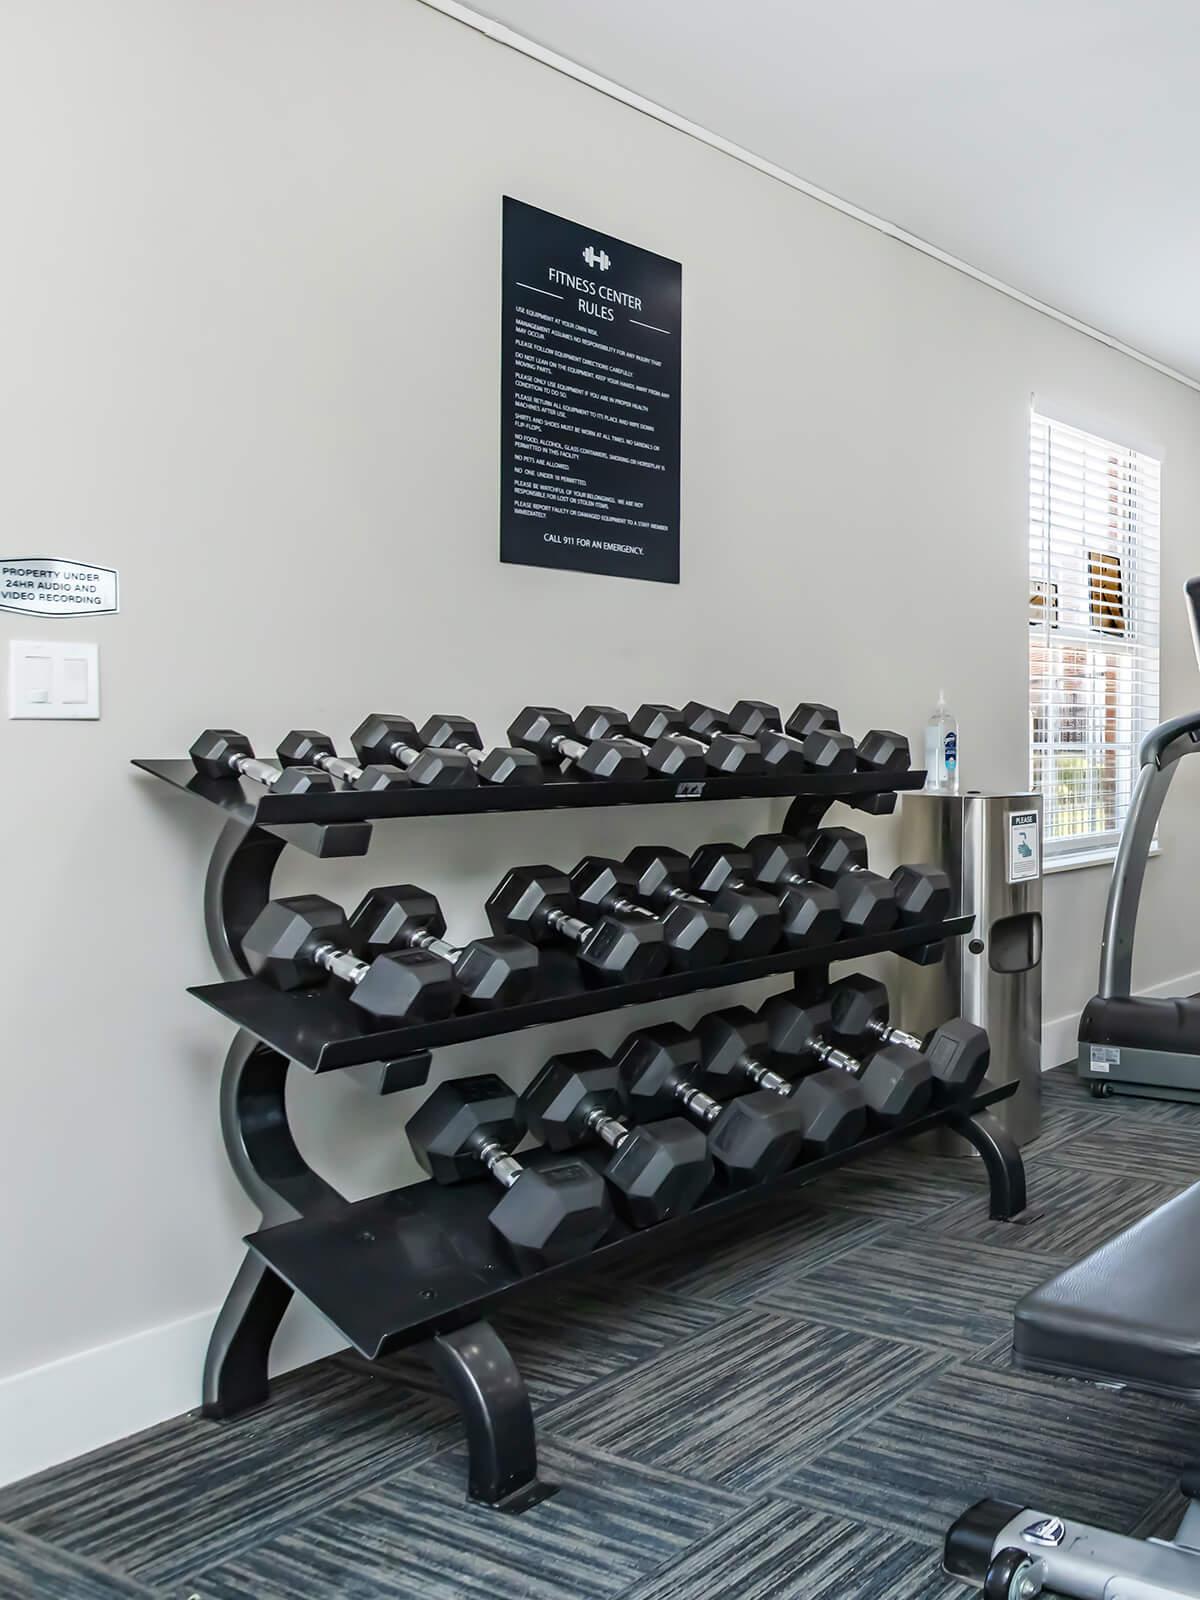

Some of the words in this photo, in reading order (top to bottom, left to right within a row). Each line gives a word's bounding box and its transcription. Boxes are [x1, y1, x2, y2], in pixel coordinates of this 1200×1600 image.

[548, 267, 595, 295] FITNESS
[598, 284, 641, 310] CENTER
[526, 309, 553, 322] EQUIPMENT
[561, 320, 574, 328] YOUR
[578, 298, 614, 321] RULES
[515, 318, 550, 334] MANAGEMENT
[551, 329, 572, 340] ASSUMES
[582, 338, 615, 353] RESPONSIBILITY
[515, 339, 532, 349] PLEASE
[533, 344, 553, 355] FOLLOW
[554, 350, 581, 363] EQUIPMENT
[582, 358, 608, 370] DIRECTIONS
[515, 359, 535, 369] MOVING
[515, 380, 543, 392] CONDITION
[607, 377, 618, 385] YOUR
[515, 372, 532, 382] PLEASE
[557, 383, 583, 395] EQUIPMENT
[614, 398, 631, 407] PROPER
[631, 402, 648, 411] HEALTH
[515, 400, 540, 411] MACHINES
[541, 407, 555, 415] AFTER
[515, 393, 531, 402] PLEASE
[533, 397, 552, 407] RETURN
[562, 404, 589, 416] EQUIPMENT
[604, 414, 617, 423] PLACE
[515, 413, 531, 422] SHIRTS
[544, 420, 559, 429] SHOES
[560, 423, 573, 432] MUST
[514, 441, 541, 452] PERMITTED
[564, 444, 578, 452] GLASS
[536, 471, 553, 479] UNDER
[514, 480, 531, 488] PLEASE
[539, 484, 564, 494] WATCHFUL
[573, 490, 585, 498] YOUR
[514, 487, 545, 498] RESPONSIBLE
[577, 498, 594, 506] STOLEN
[514, 500, 531, 509] PLEASE
[532, 503, 551, 512] REPORT
[552, 506, 568, 515] FAULTY
[577, 511, 600, 520] DAMAGED
[601, 514, 625, 524] EQUIPMENT
[543, 533, 562, 544] CALL
[563, 536, 575, 545] 911
[576, 537, 590, 547] FOR
[591, 540, 602, 549] AN
[603, 541, 644, 555] EMERGENCY.
[2, 567, 60, 578] PROPERTY
[63, 573, 100, 581] UNDER
[6, 579, 34, 589] 24HR
[37, 581, 71, 592] AUDIO
[75, 584, 97, 593] AND
[1, 591, 35, 601] VIDEO
[38, 593, 102, 605] RECORDING
[1015, 815, 1033, 825] PLEASE
